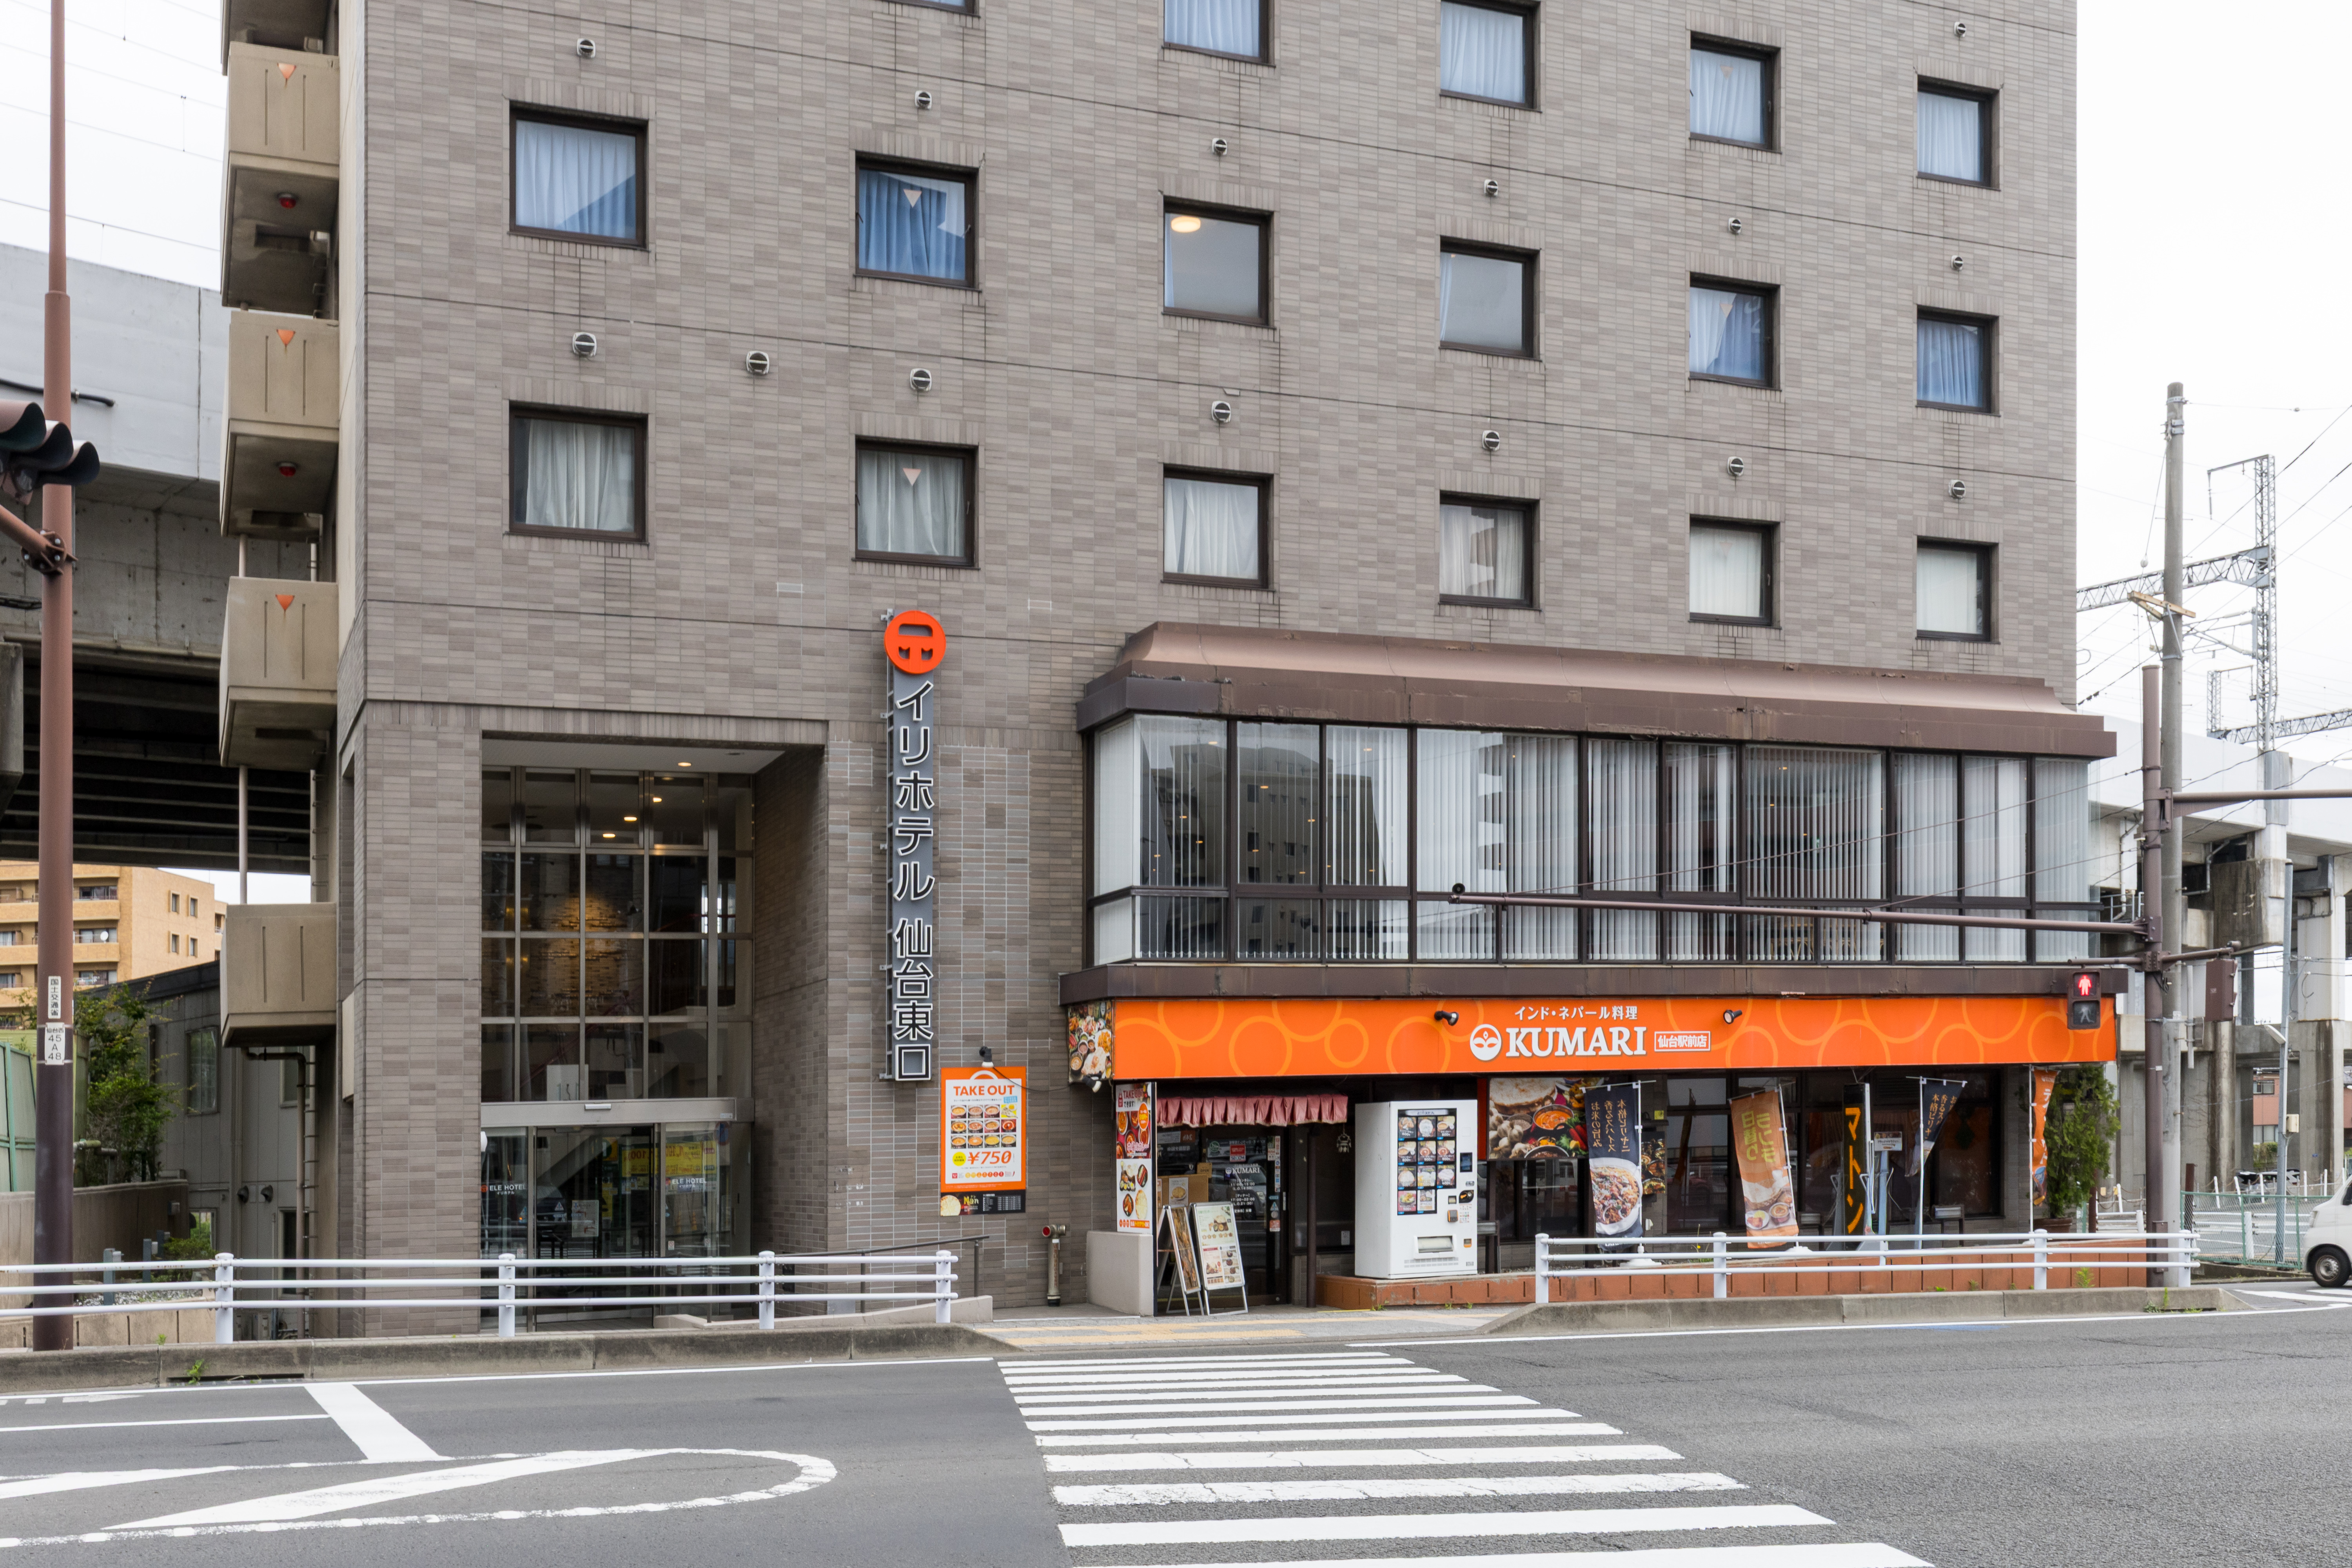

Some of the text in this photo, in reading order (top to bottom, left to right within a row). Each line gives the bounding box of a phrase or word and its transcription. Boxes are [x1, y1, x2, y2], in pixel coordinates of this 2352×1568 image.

[893, 681, 935, 1081] イリホテル 仙台東口
[51, 978, 59, 1016] 国土交通省
[1515, 1006, 1638, 1020] インド・ネパール料理
[1506, 1026, 1646, 1057] KUMARI
[1657, 1034, 1708, 1049] 仙台駅前店
[953, 1085, 1014, 1096] TAKE OUT
[1123, 1090, 1134, 1099] TAKE
[967, 1151, 1012, 1165] ¥750
[1845, 1107, 1864, 1234] マトン
